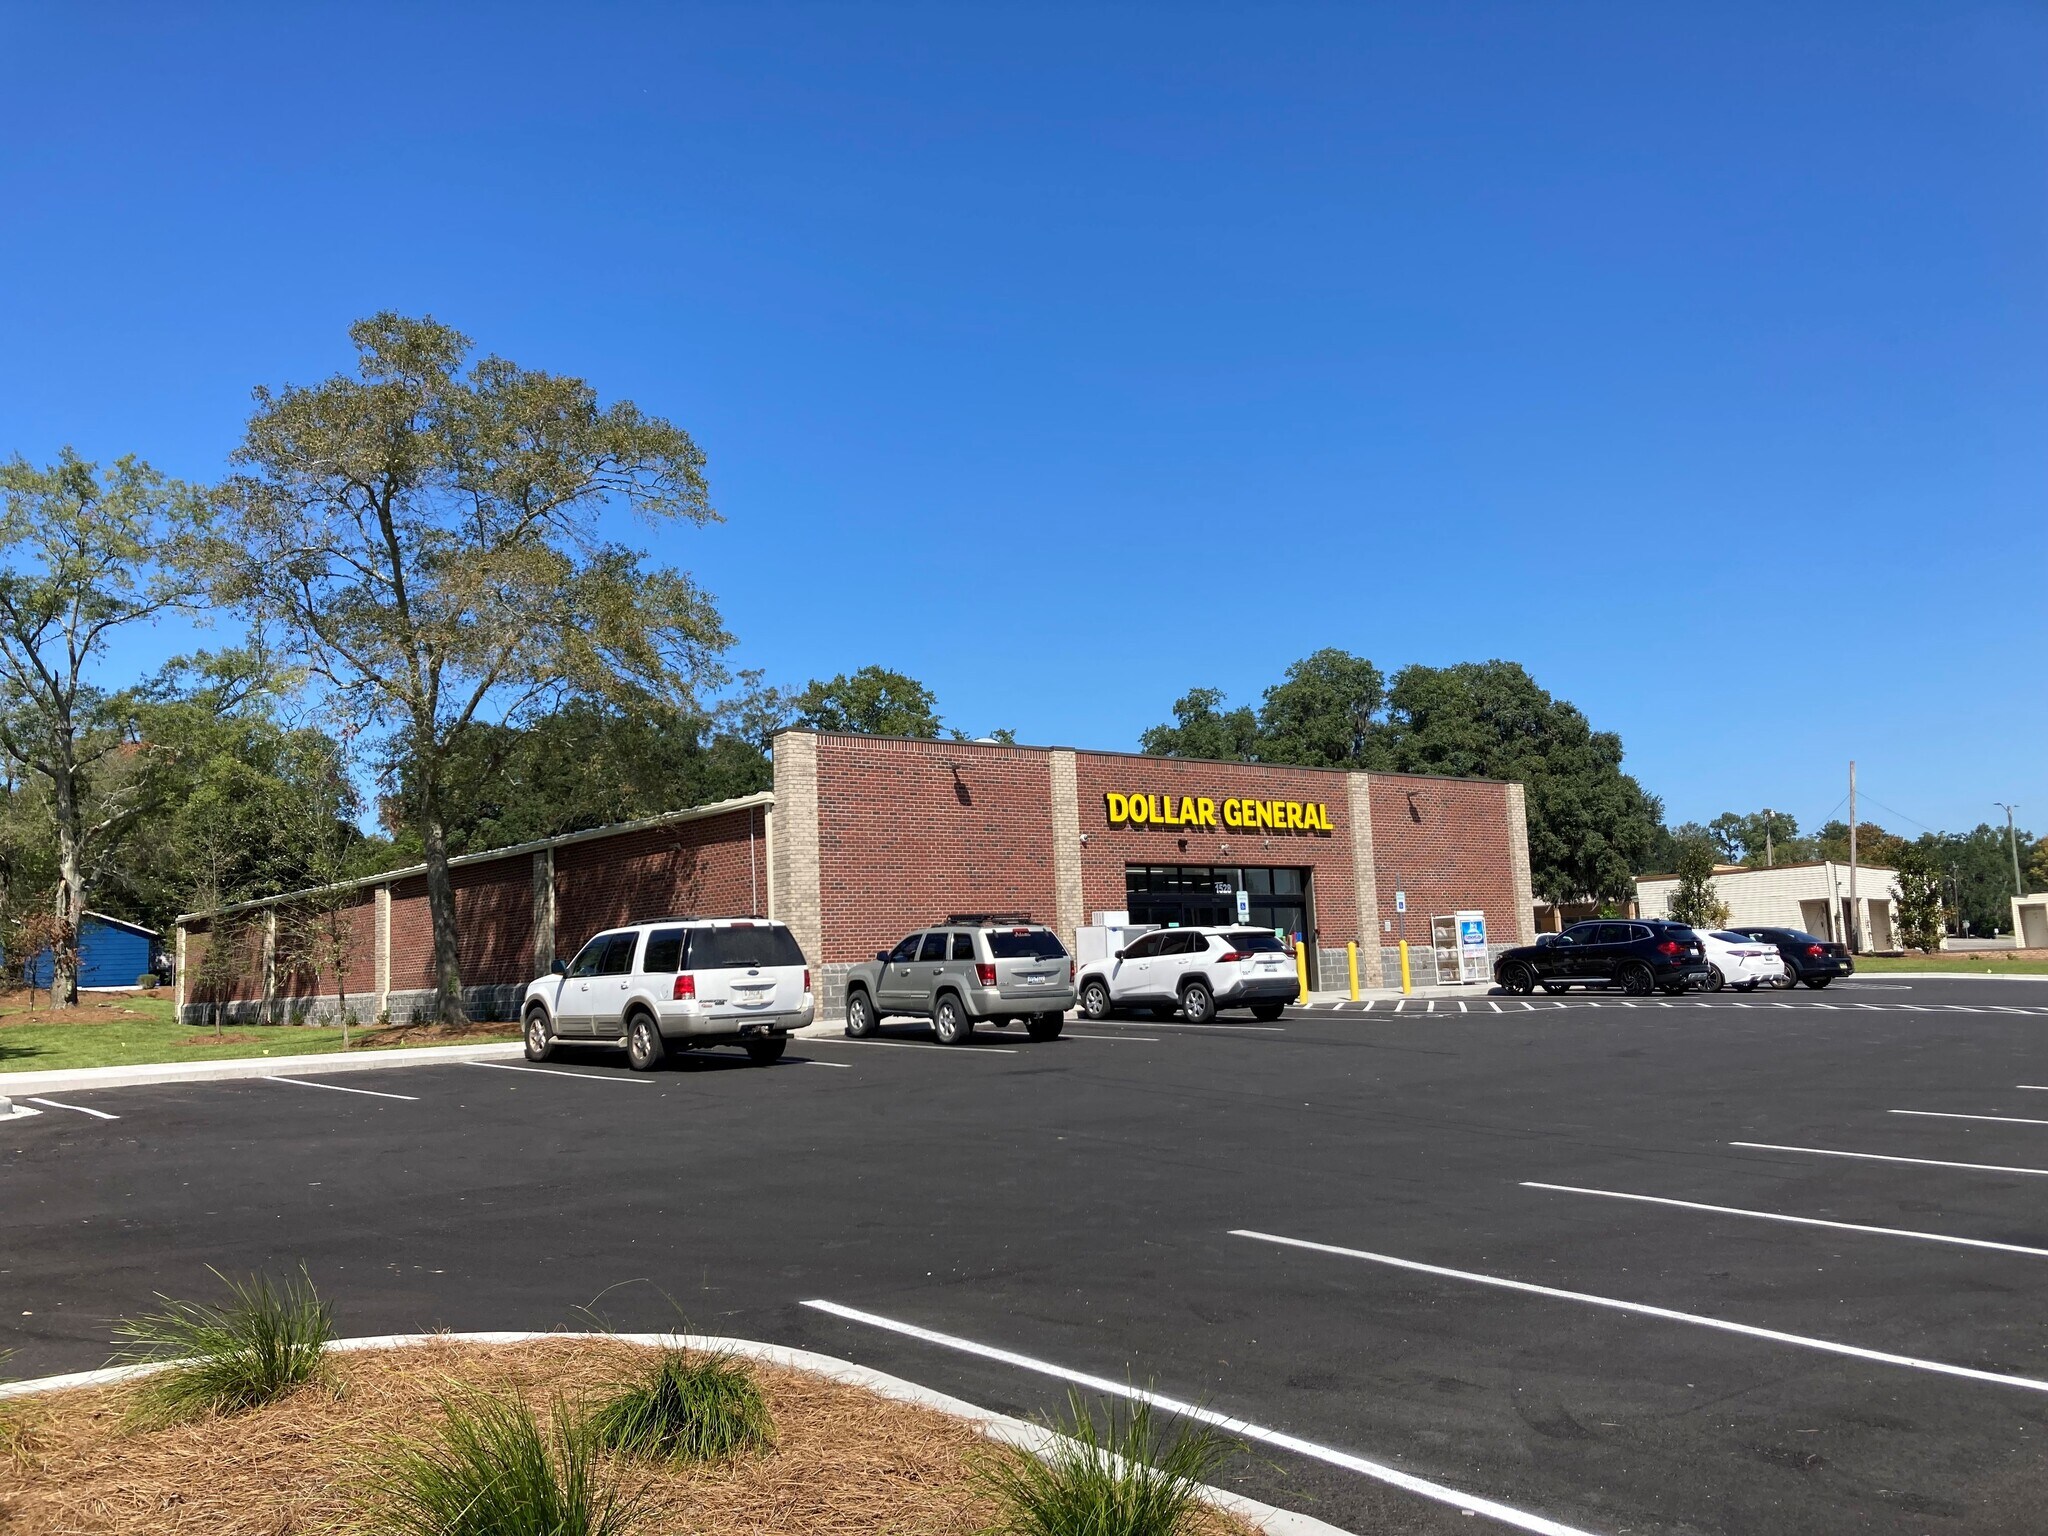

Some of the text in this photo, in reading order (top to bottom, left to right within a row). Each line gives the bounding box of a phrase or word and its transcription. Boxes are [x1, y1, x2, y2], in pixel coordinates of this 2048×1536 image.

[1106, 793, 1334, 830] DOLLAR GENERAL
[1214, 883, 1232, 894] 1528
